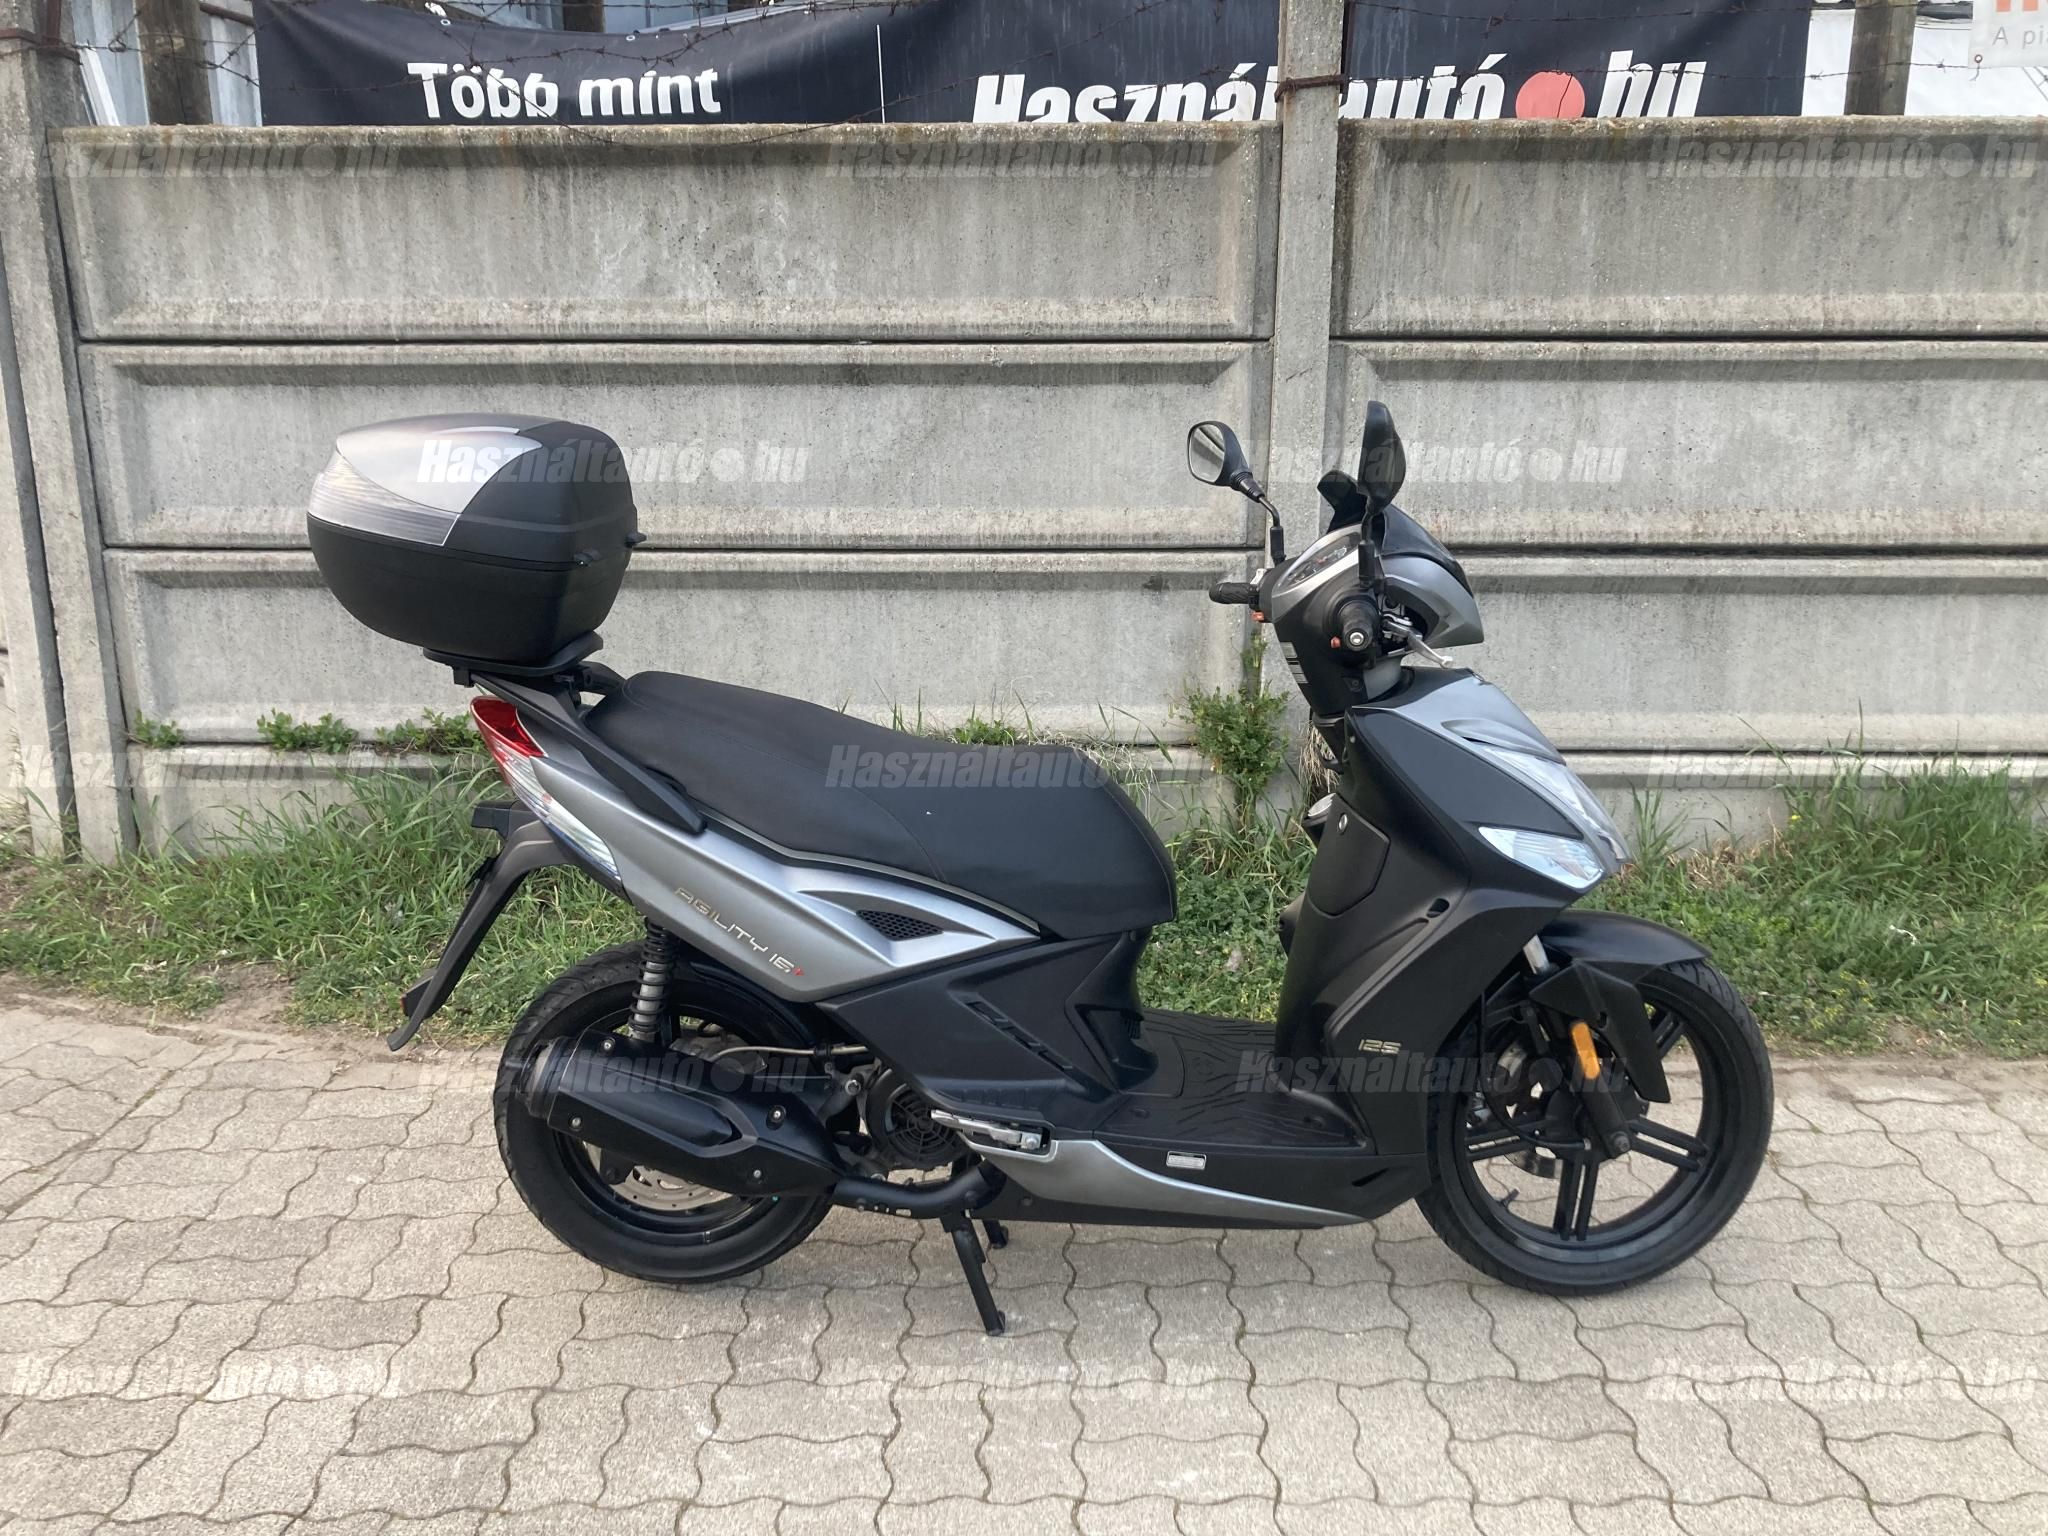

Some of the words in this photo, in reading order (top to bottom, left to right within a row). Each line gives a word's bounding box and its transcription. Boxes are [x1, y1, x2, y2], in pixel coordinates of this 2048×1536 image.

[1992, 26, 2009, 46] A
[407, 62, 560, 119] Több
[579, 68, 722, 117] mint
[1358, 1039, 1402, 1054] 125
